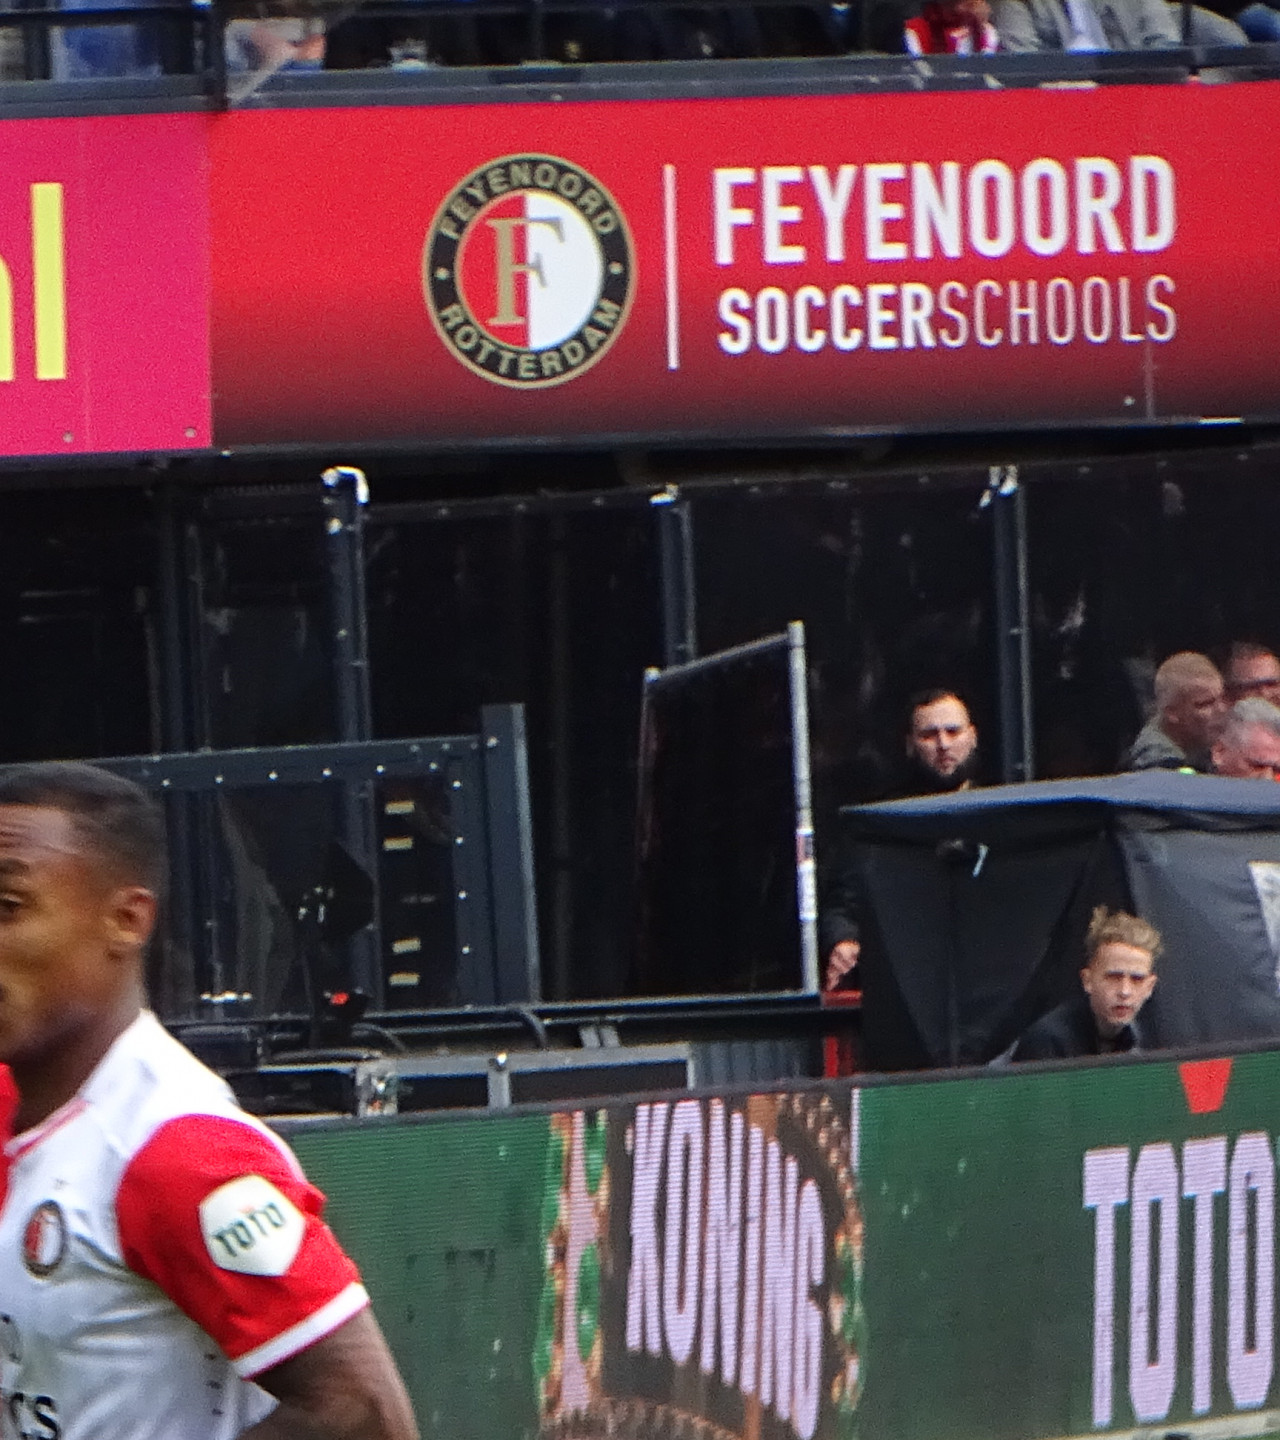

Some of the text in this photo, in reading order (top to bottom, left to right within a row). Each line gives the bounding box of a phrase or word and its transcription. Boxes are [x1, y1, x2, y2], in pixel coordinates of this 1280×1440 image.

[442, 162, 617, 239] FEYENOORD
[713, 155, 1177, 265] FEYENOORD
[485, 216, 565, 326] F
[441, 298, 621, 379] ROTTERDAM
[717, 274, 1178, 355] SOCCERSCHOOLS
[212, 1202, 286, 1258] TOTO
[1082, 1131, 1277, 1429] TOTO
